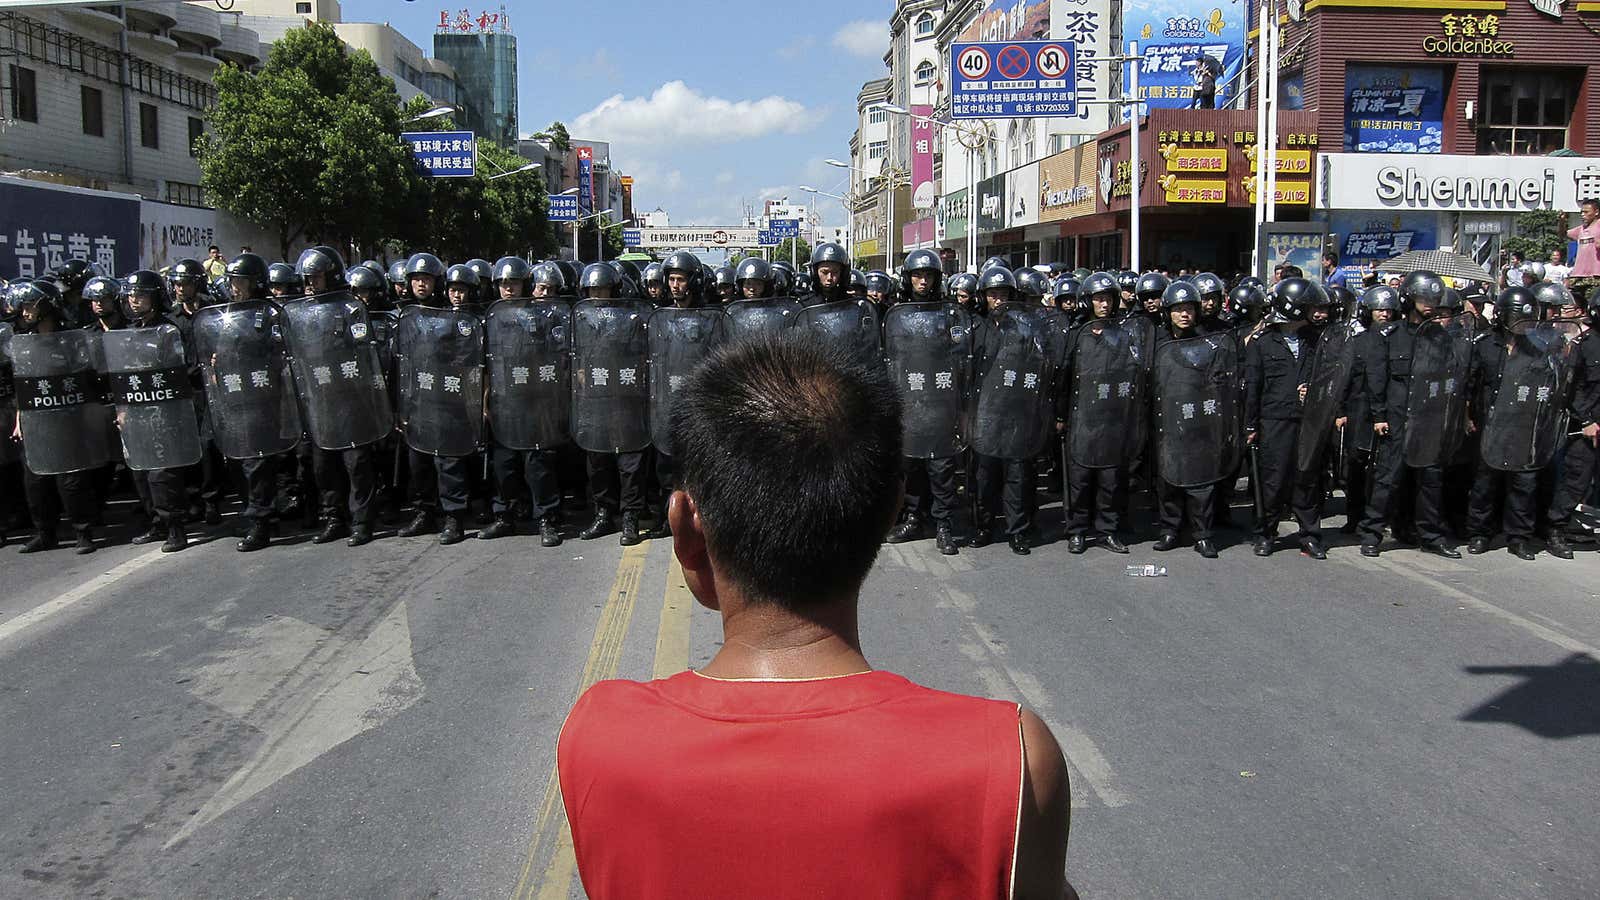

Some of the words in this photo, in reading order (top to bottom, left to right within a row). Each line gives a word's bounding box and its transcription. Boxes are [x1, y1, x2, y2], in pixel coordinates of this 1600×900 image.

[1440, 13, 1500, 37] 金蜜蜂
[1145, 45, 1200, 56] SUMMER
[1423, 35, 1514, 54] GoldenBee
[963, 55, 983, 71] 40
[1351, 89, 1401, 97] SUMMER
[1351, 89, 1426, 117] 清凉一夏
[1158, 130, 1216, 143] 台湾金蜜蜂
[1287, 133, 1318, 145] 启东店
[415, 157, 472, 169] 发展民受益
[1177, 158, 1222, 169] 商务简餐
[1177, 189, 1222, 200] 果汁茶咖
[1264, 189, 1306, 201] 色小吃
[1376, 165, 1555, 206] Shenmei
[1346, 232, 1414, 256] 清凉一夏
[128, 372, 167, 391] 警察
[223, 370, 270, 393] 警察
[313, 361, 359, 385] 警察
[416, 371, 461, 393] 警察
[511, 364, 556, 385] 警察
[591, 367, 636, 386] 警察
[907, 371, 952, 391] 警察
[1003, 369, 1038, 389] 警察
[37, 377, 78, 395] 警察
[126, 388, 174, 403] POLICE
[1097, 381, 1131, 399] 警察
[1517, 385, 1549, 402] 警察
[34, 392, 85, 408] POLICE
[1181, 399, 1217, 419] 警察
